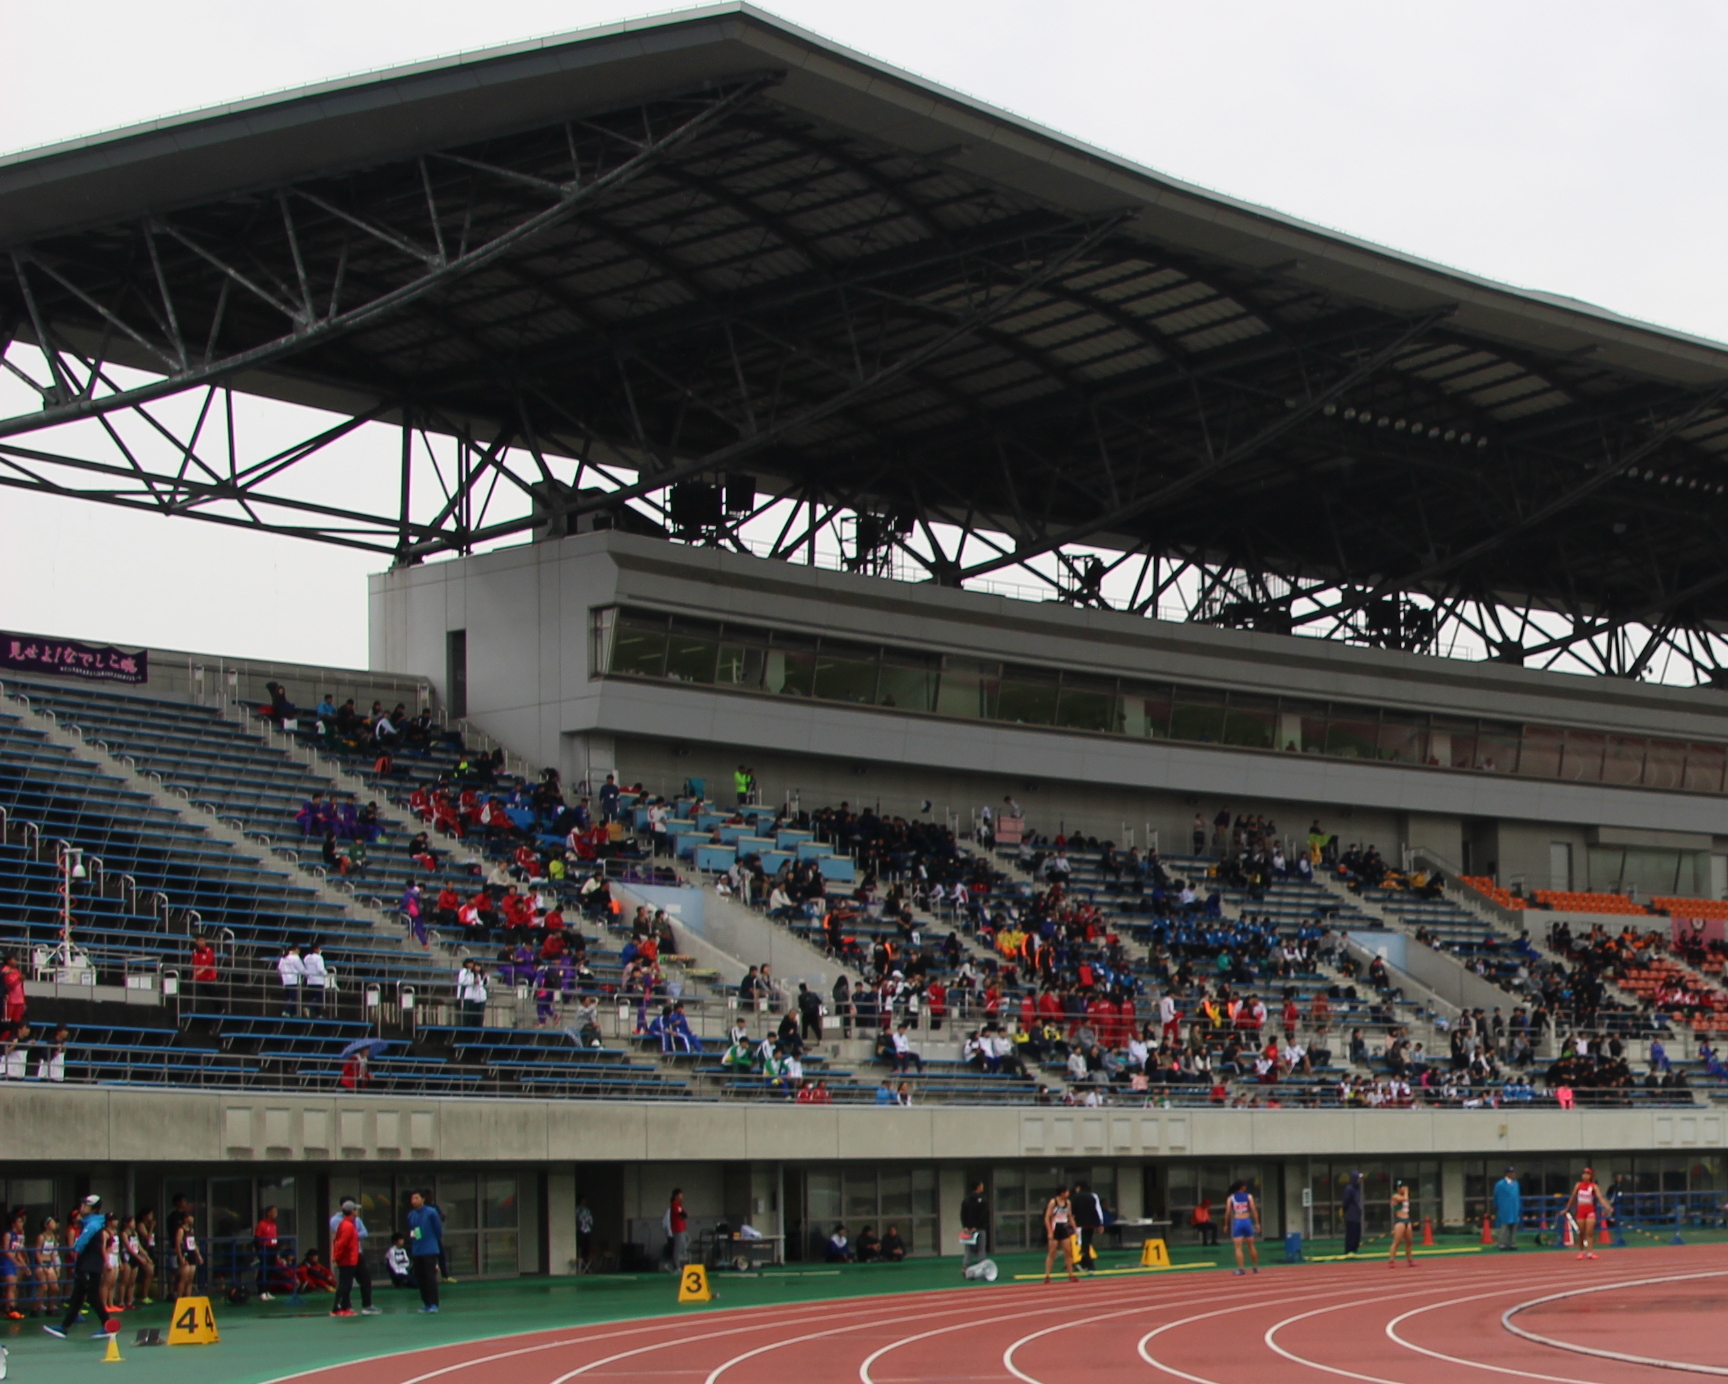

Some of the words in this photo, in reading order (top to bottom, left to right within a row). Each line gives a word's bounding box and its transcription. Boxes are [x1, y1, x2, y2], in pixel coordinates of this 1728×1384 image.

[1152, 1244, 1161, 1260] 1
[686, 1272, 702, 1293] 3
[176, 1306, 199, 1334] 4
[205, 1305, 214, 1333] 4
